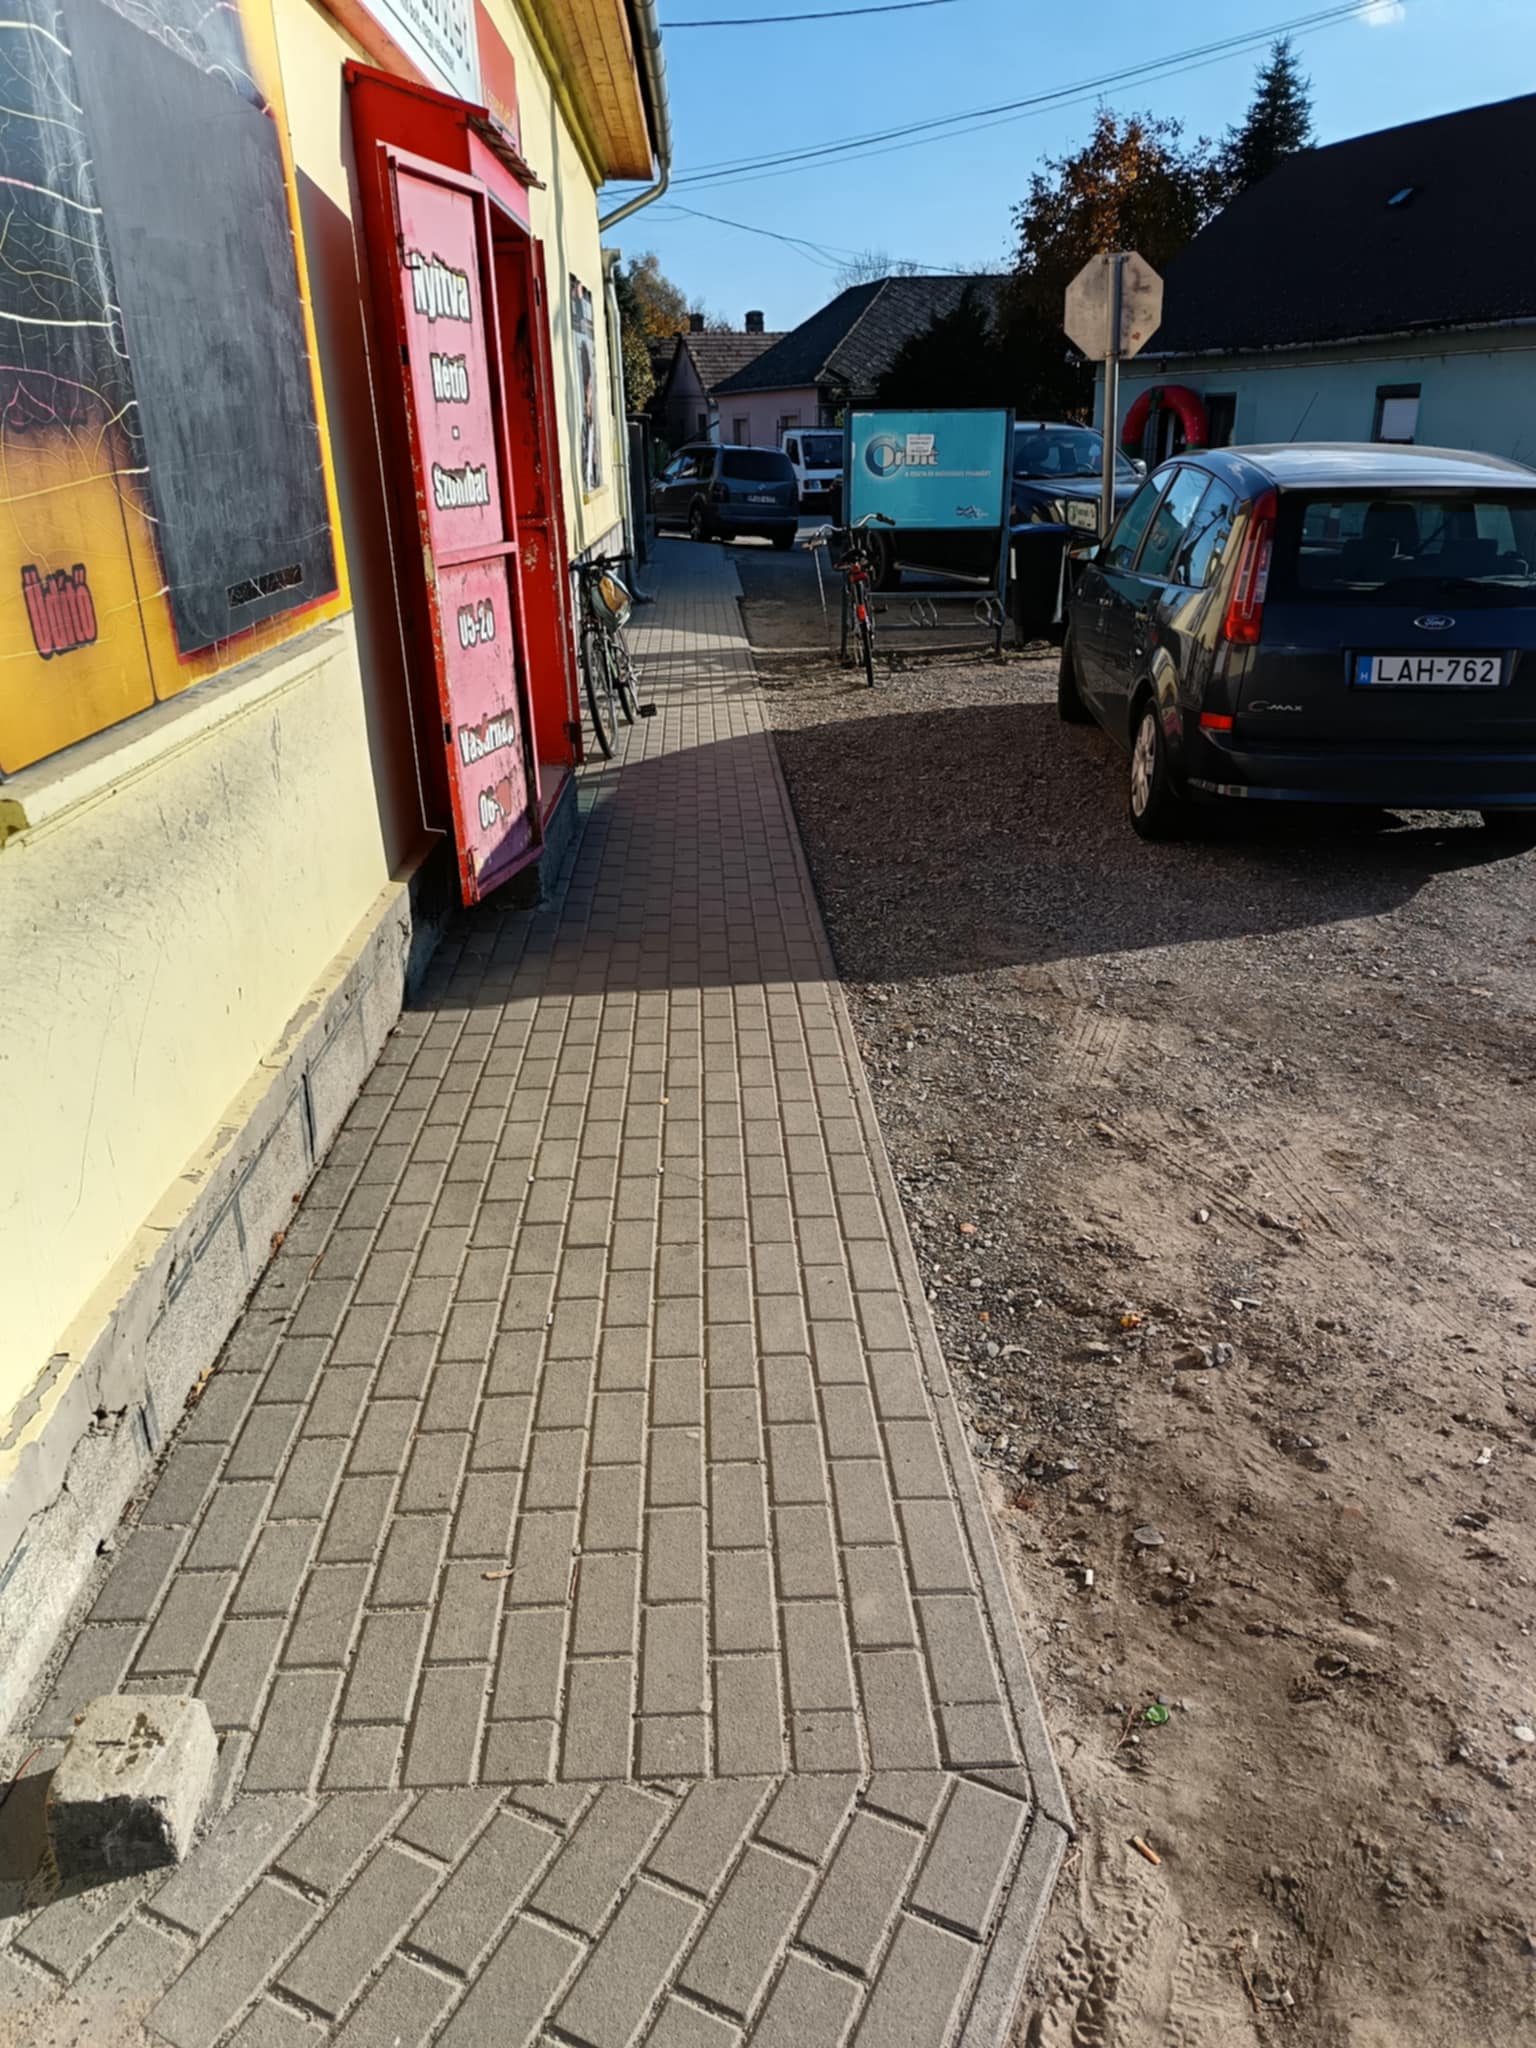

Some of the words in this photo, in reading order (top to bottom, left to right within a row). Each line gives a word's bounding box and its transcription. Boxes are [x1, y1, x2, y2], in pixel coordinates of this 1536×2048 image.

[410, 248, 472, 323] Nyitva
[432, 461, 491, 511] Szombat
[1360, 672, 1369, 681] H
[1377, 659, 1494, 683] LAH-762
